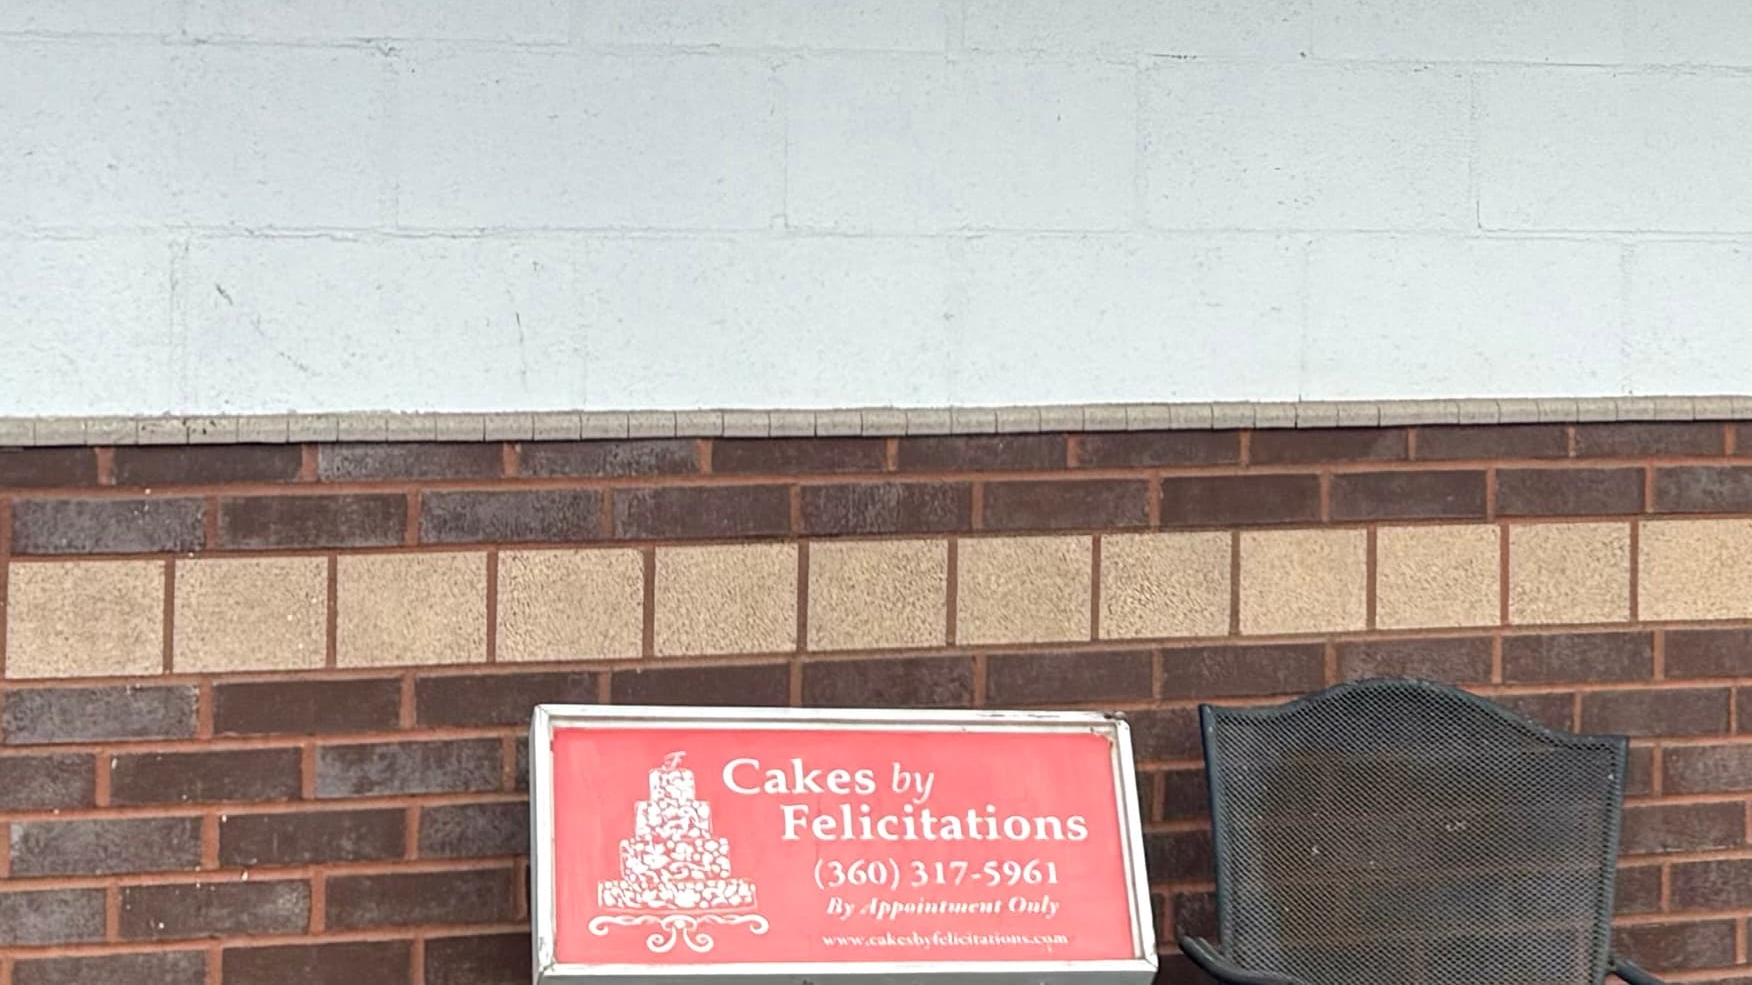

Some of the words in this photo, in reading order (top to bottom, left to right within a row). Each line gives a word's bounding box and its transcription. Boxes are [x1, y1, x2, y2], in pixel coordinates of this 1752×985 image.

[722, 758, 876, 795] Cakes
[892, 762, 934, 803] by
[780, 803, 1089, 842] Felicitations
[814, 858, 900, 891] (360)
[910, 860, 1059, 888] 317-5961
[827, 896, 855, 920] By
[859, 896, 1002, 920] Appointment
[1008, 894, 1060, 920] Only
[821, 930, 1069, 951] www.cakesbyfelicitations.com
